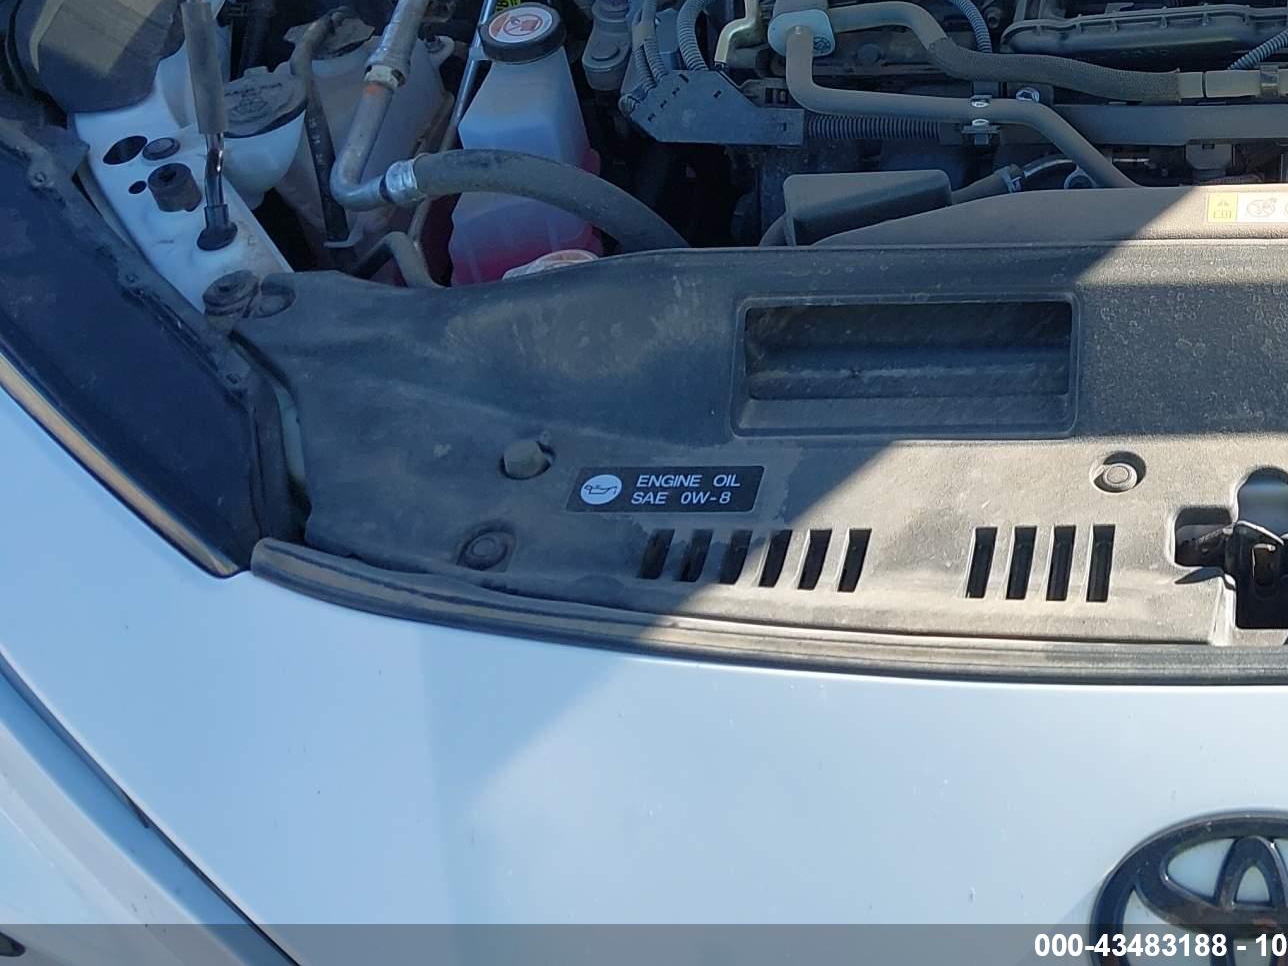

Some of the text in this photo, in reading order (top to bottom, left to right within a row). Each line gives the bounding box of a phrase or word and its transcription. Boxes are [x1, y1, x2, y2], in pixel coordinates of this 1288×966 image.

[636, 474, 741, 488] ENGINE OIL
[631, 491, 732, 505] SAE 0W-8
